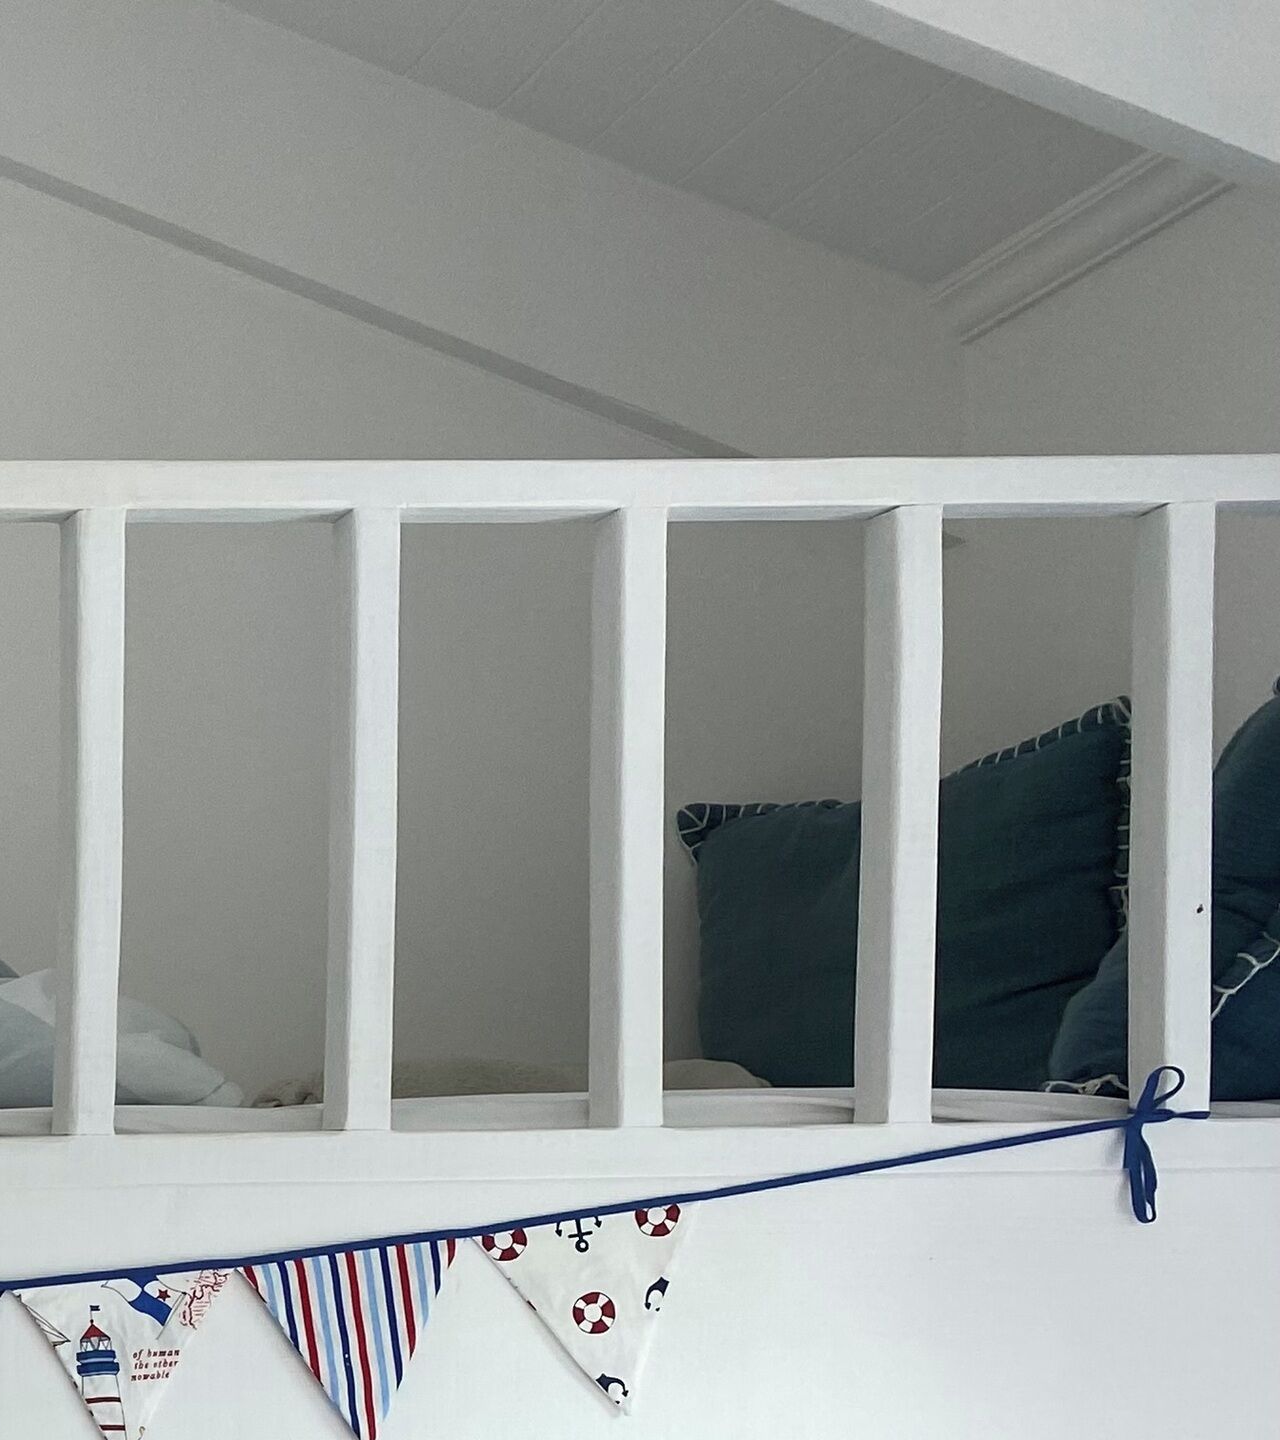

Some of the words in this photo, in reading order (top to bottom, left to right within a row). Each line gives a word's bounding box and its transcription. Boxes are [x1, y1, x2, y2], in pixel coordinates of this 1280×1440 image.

[133, 1348, 144, 1361] of
[147, 1348, 180, 1358] human
[134, 1360, 149, 1370] the
[153, 1358, 179, 1368] other
